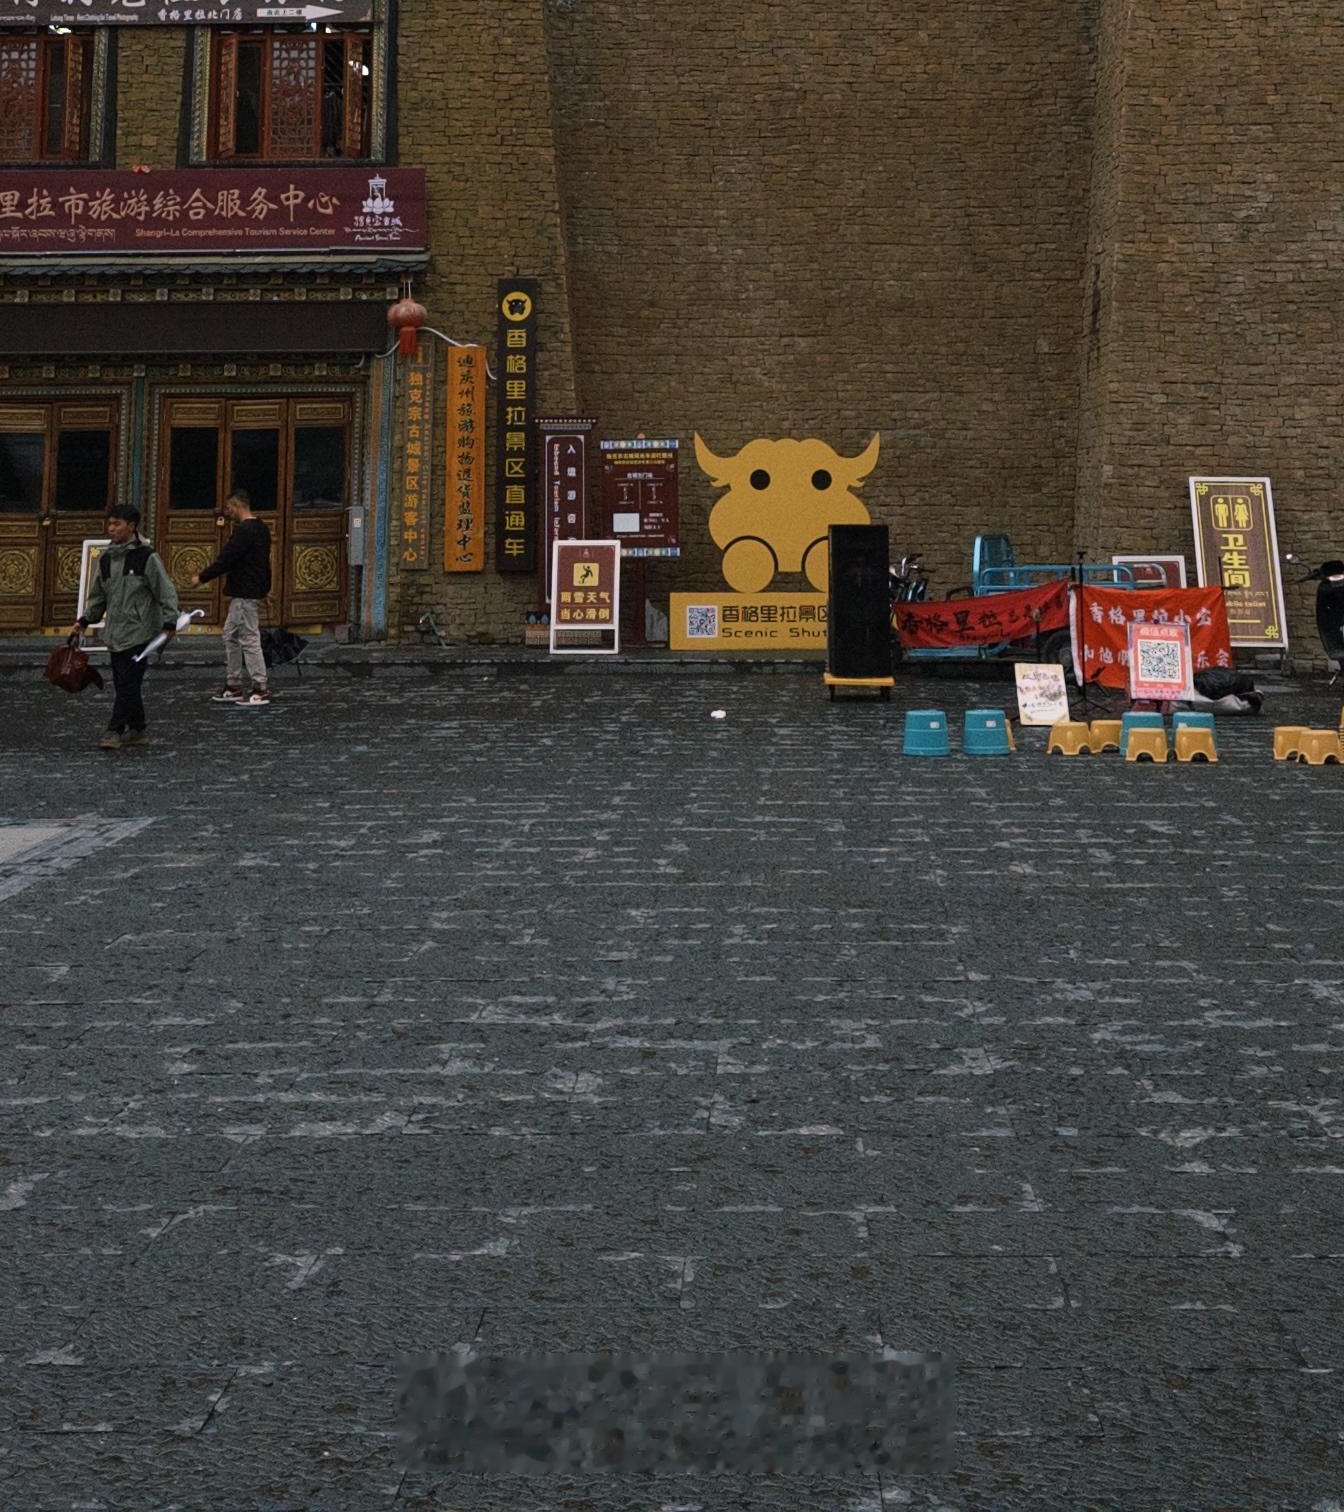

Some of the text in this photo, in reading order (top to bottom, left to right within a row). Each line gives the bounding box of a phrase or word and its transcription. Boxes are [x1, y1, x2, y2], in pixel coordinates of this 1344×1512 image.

[157, 8, 243, 21] 香格里拉北门店
[135, 228, 180, 239] Shangri-La
[182, 227, 243, 238] Comprehensive
[245, 227, 278, 236] Tourism
[280, 227, 308, 236] Service
[309, 227, 336, 236] Center
[505, 329, 527, 558] 香格里拉景区直通车
[403, 371, 424, 562] 独克宗古城景区游客中心
[1219, 534, 1252, 588] 卫生间
[560, 591, 610, 603] 雨雪天气
[560, 608, 610, 620] 当心滑倒
[722, 605, 828, 623] 香格里拉景区
[722, 627, 778, 638] Scenic
